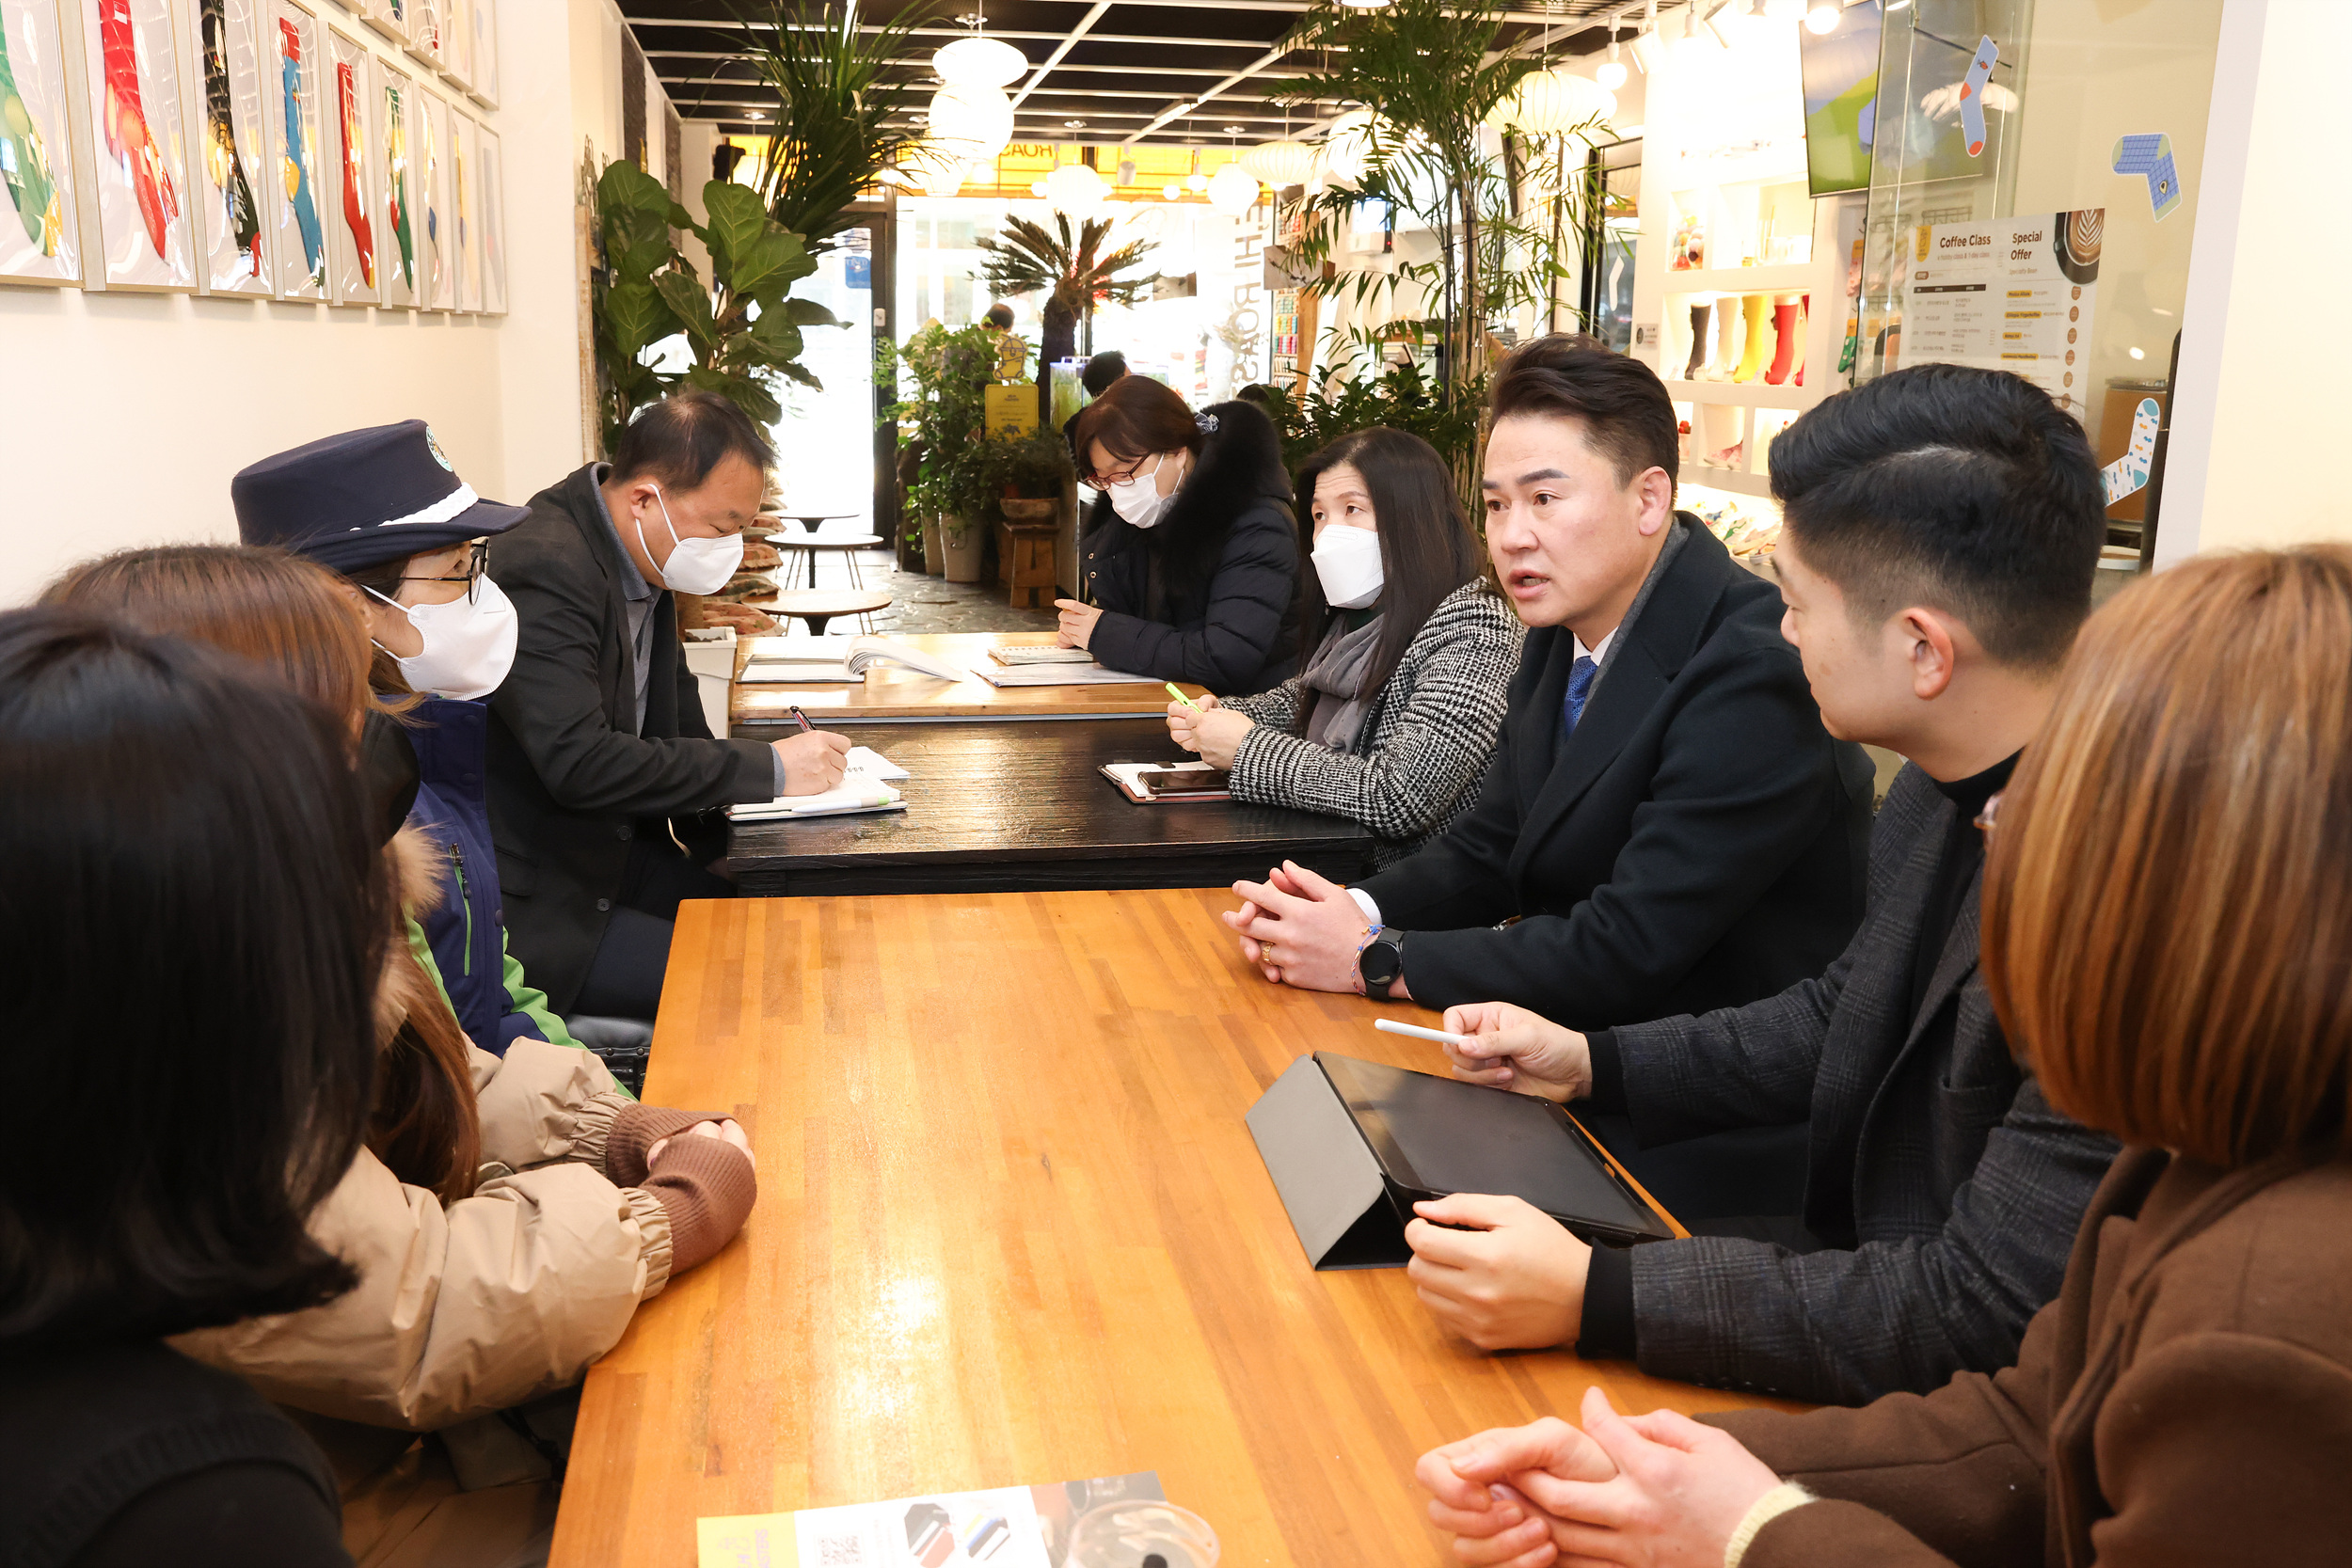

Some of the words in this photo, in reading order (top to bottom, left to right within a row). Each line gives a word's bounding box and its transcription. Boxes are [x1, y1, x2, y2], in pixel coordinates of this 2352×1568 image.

[1940, 235, 1967, 248] Coffee
[1969, 233, 1992, 245] Class
[2011, 230, 2042, 245] Special
[2010, 248, 2032, 261] Offer
